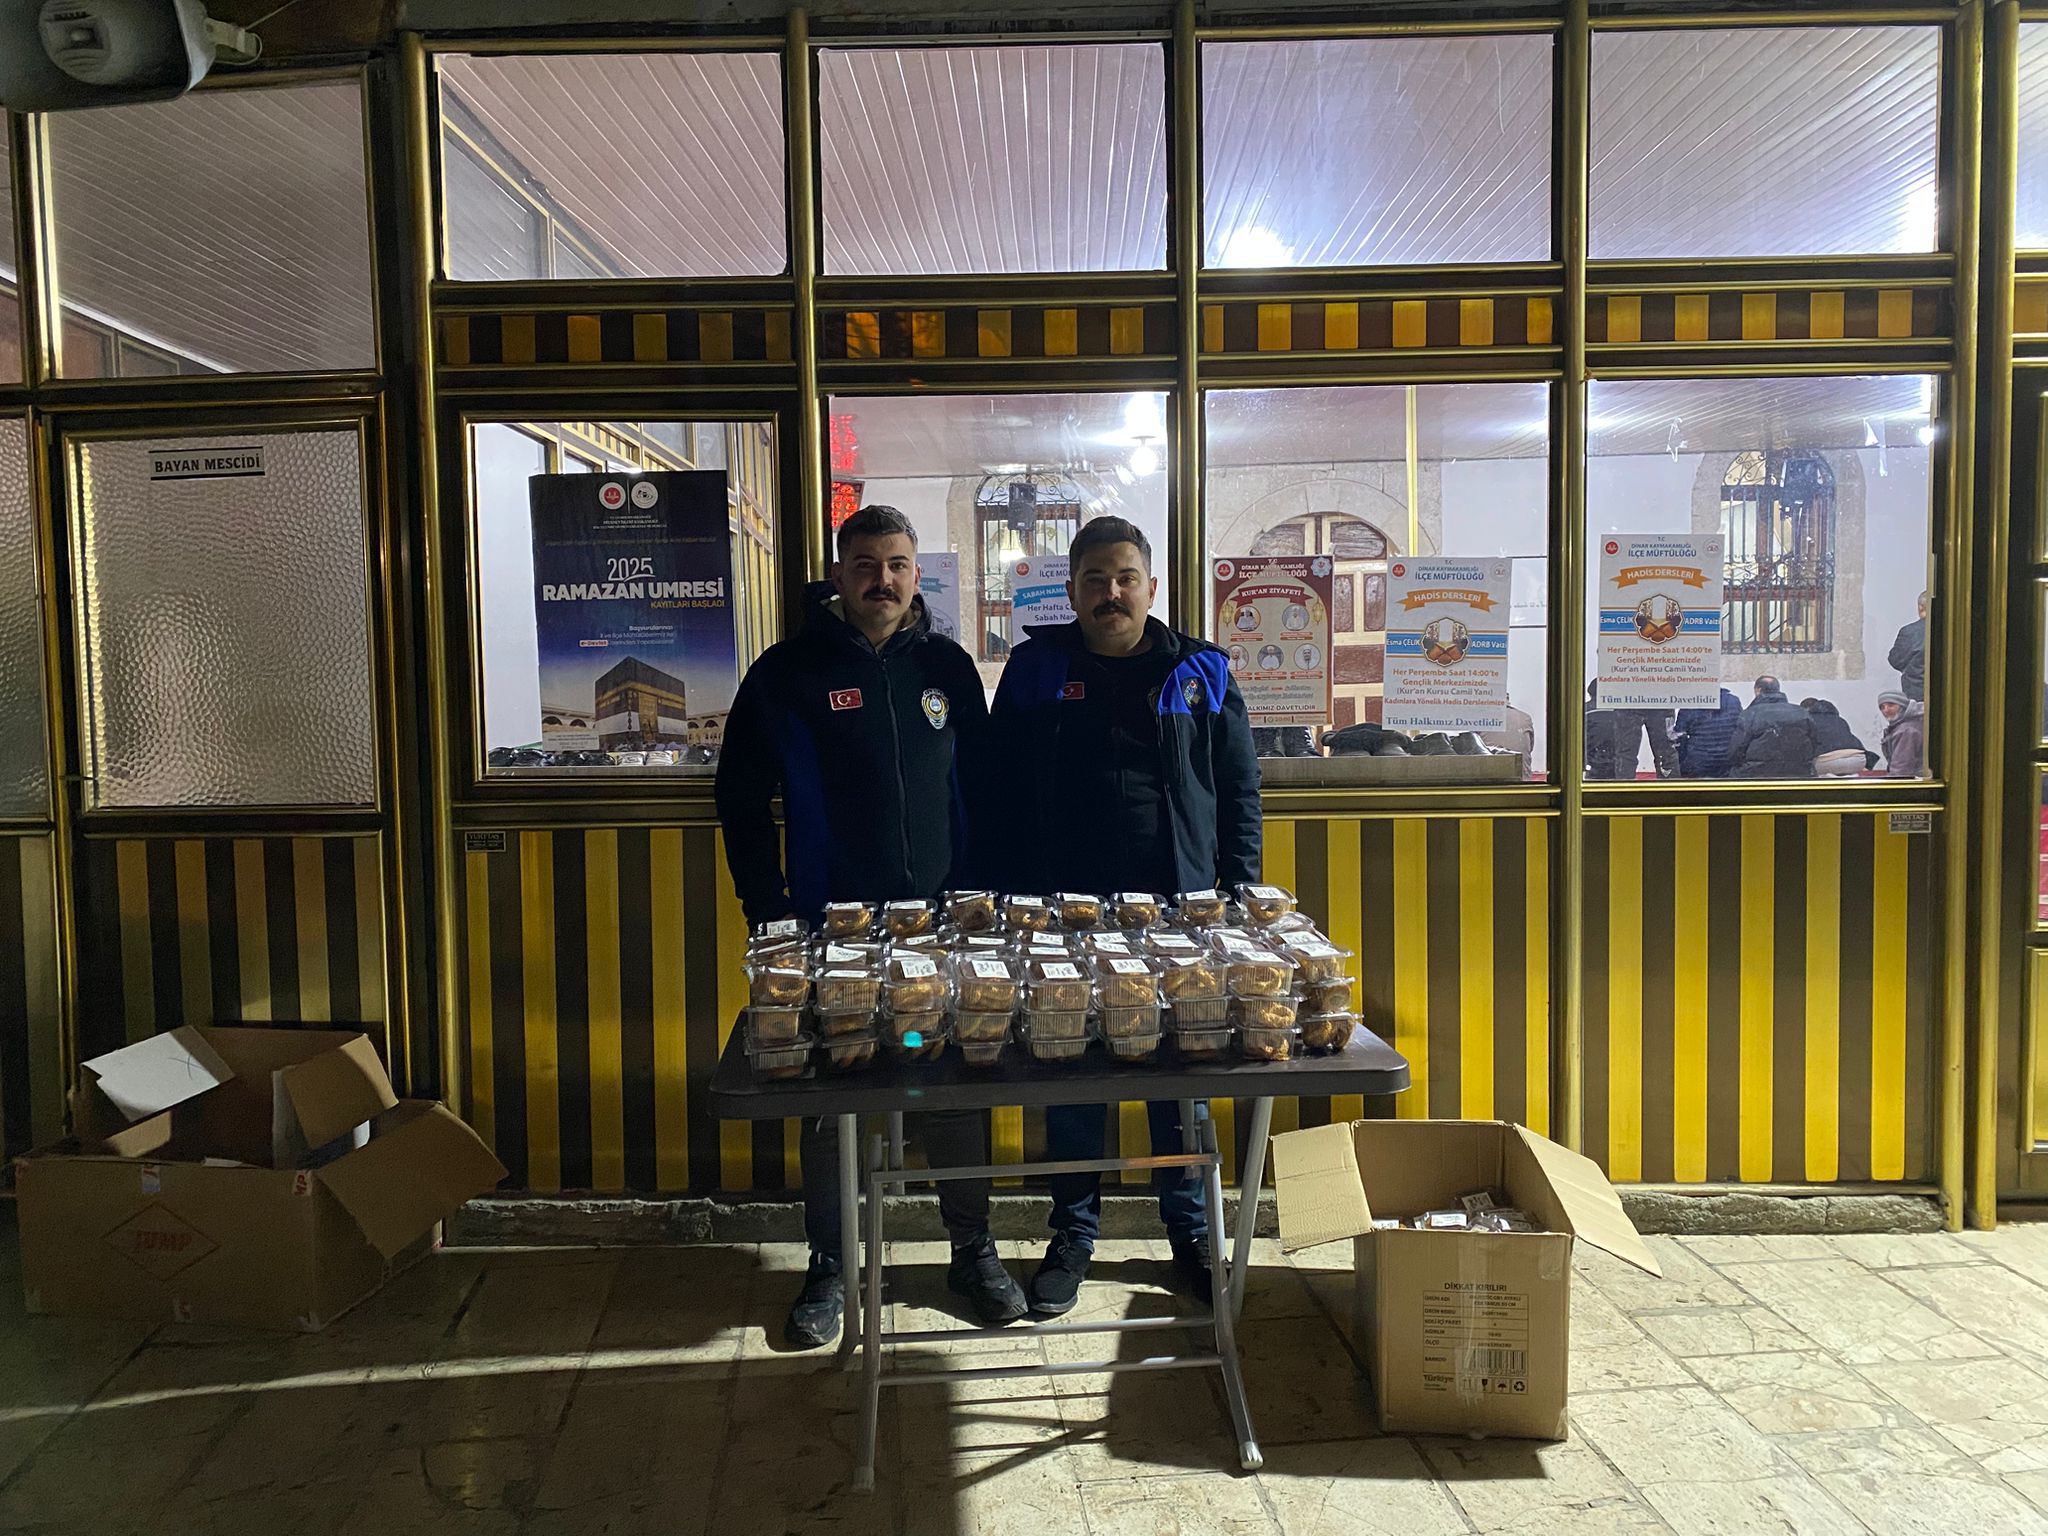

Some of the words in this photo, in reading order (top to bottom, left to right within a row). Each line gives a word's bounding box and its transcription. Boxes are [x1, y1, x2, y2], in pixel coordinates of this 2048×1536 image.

[155, 459, 200, 472] BAYAN
[204, 453, 260, 470] MESCİDİ
[1628, 548, 1645, 559] İLÇE
[1646, 548, 1697, 557] MÜFTÜLÜĞÜ
[607, 557, 656, 582] 2025
[1039, 569, 1055, 578] İLÇE
[1627, 568, 1653, 579] HADİS
[1655, 569, 1694, 579] DERSLERİ
[1415, 571, 1432, 582] İLÇE
[1433, 571, 1484, 580] MÜFTÜLÜĞÜ
[542, 581, 644, 601] RAMAZAN
[648, 577, 724, 599] UMRESİ
[1022, 590, 1046, 599] SABAH
[1046, 587, 1066, 596] NAMA
[1241, 588, 1268, 598] KUR'AN
[1269, 587, 1301, 597] ZİYAFETİ
[1414, 592, 1440, 602] HADİS
[1442, 592, 1481, 602] DERSLERİ
[650, 600, 691, 609] KAYITLARI
[691, 599, 725, 609] BAŞLADI
[1042, 603, 1063, 611] Hafta
[1616, 615, 1633, 625] ÇELİK
[1684, 617, 1704, 625] ADRB
[1386, 638, 1402, 646] Esma
[1403, 638, 1421, 647] ÇELİK
[1471, 640, 1491, 648] ADRB
[1607, 646, 1621, 654] Her
[1622, 646, 1661, 656] Perşembe
[1681, 646, 1712, 654] 14:00'te
[1616, 656, 1646, 665] Gençlik
[1647, 656, 1701, 664] Merkezimizde
[1408, 669, 1447, 678] Perşembe
[1468, 669, 1499, 677] 14:00'te
[1611, 665, 1639, 674] (Kur'an
[1664, 665, 1685, 673] Camii
[1687, 665, 1707, 674] Yanı)
[1402, 678, 1432, 688] Gençlik
[1433, 679, 1488, 687] Merkezimizde
[1599, 675, 1630, 683] Kadınlara
[1631, 675, 1656, 683] Yönelik
[1657, 675, 1676, 683] Hadis
[1397, 687, 1424, 696] (Kur'an
[1474, 688, 1493, 697] Yanı)
[1417, 697, 1441, 705] Yönelik
[1463, 698, 1505, 706] Derslerimize
[1601, 695, 1622, 704] Tüm
[1624, 695, 1667, 704] Halkımız
[1670, 695, 1717, 704] Davetlidir
[1386, 716, 1407, 725] Tüm
[1410, 716, 1453, 726] Halkımız
[1456, 717, 1503, 727] Davetlidir
[1444, 1282, 1474, 1290] DİKKAT
